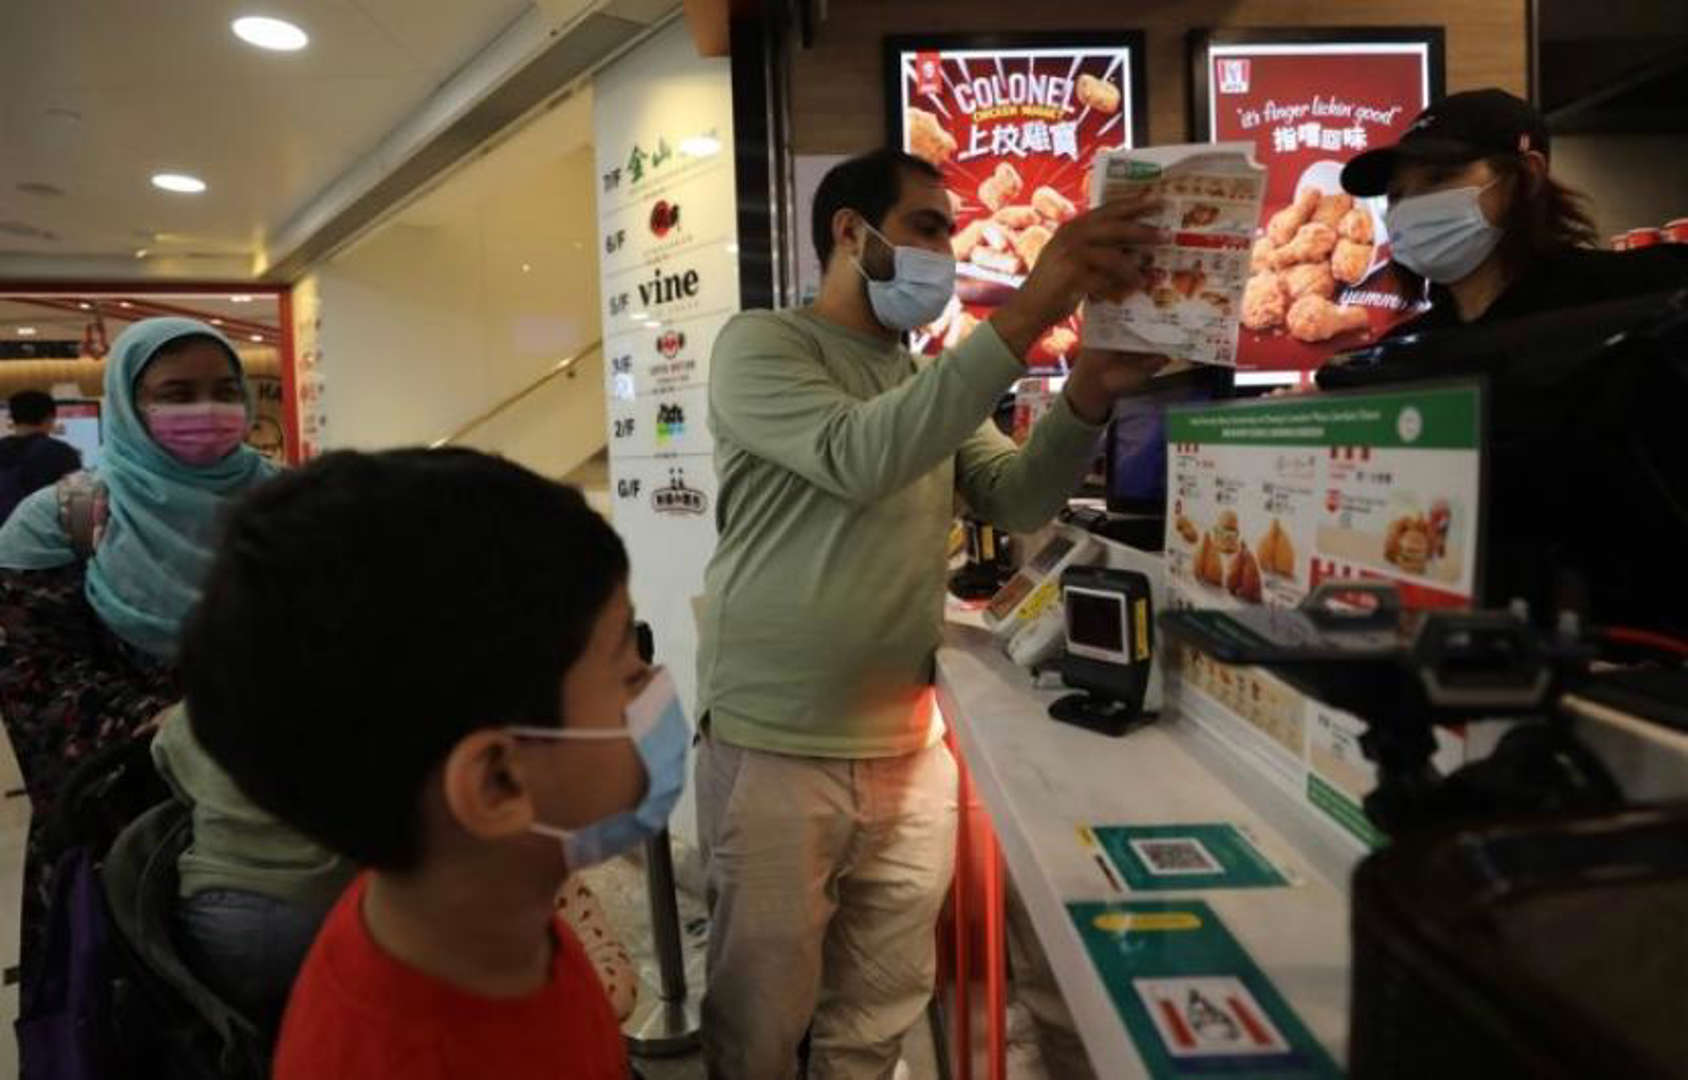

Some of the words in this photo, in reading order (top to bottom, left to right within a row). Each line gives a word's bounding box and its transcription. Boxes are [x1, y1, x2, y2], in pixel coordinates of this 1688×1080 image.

[953, 73, 1075, 114] COLONEL
[1263, 100, 1310, 124] finger
[638, 268, 699, 307] vine
[614, 418, 635, 438] 2/F
[617, 479, 640, 498] G/F
